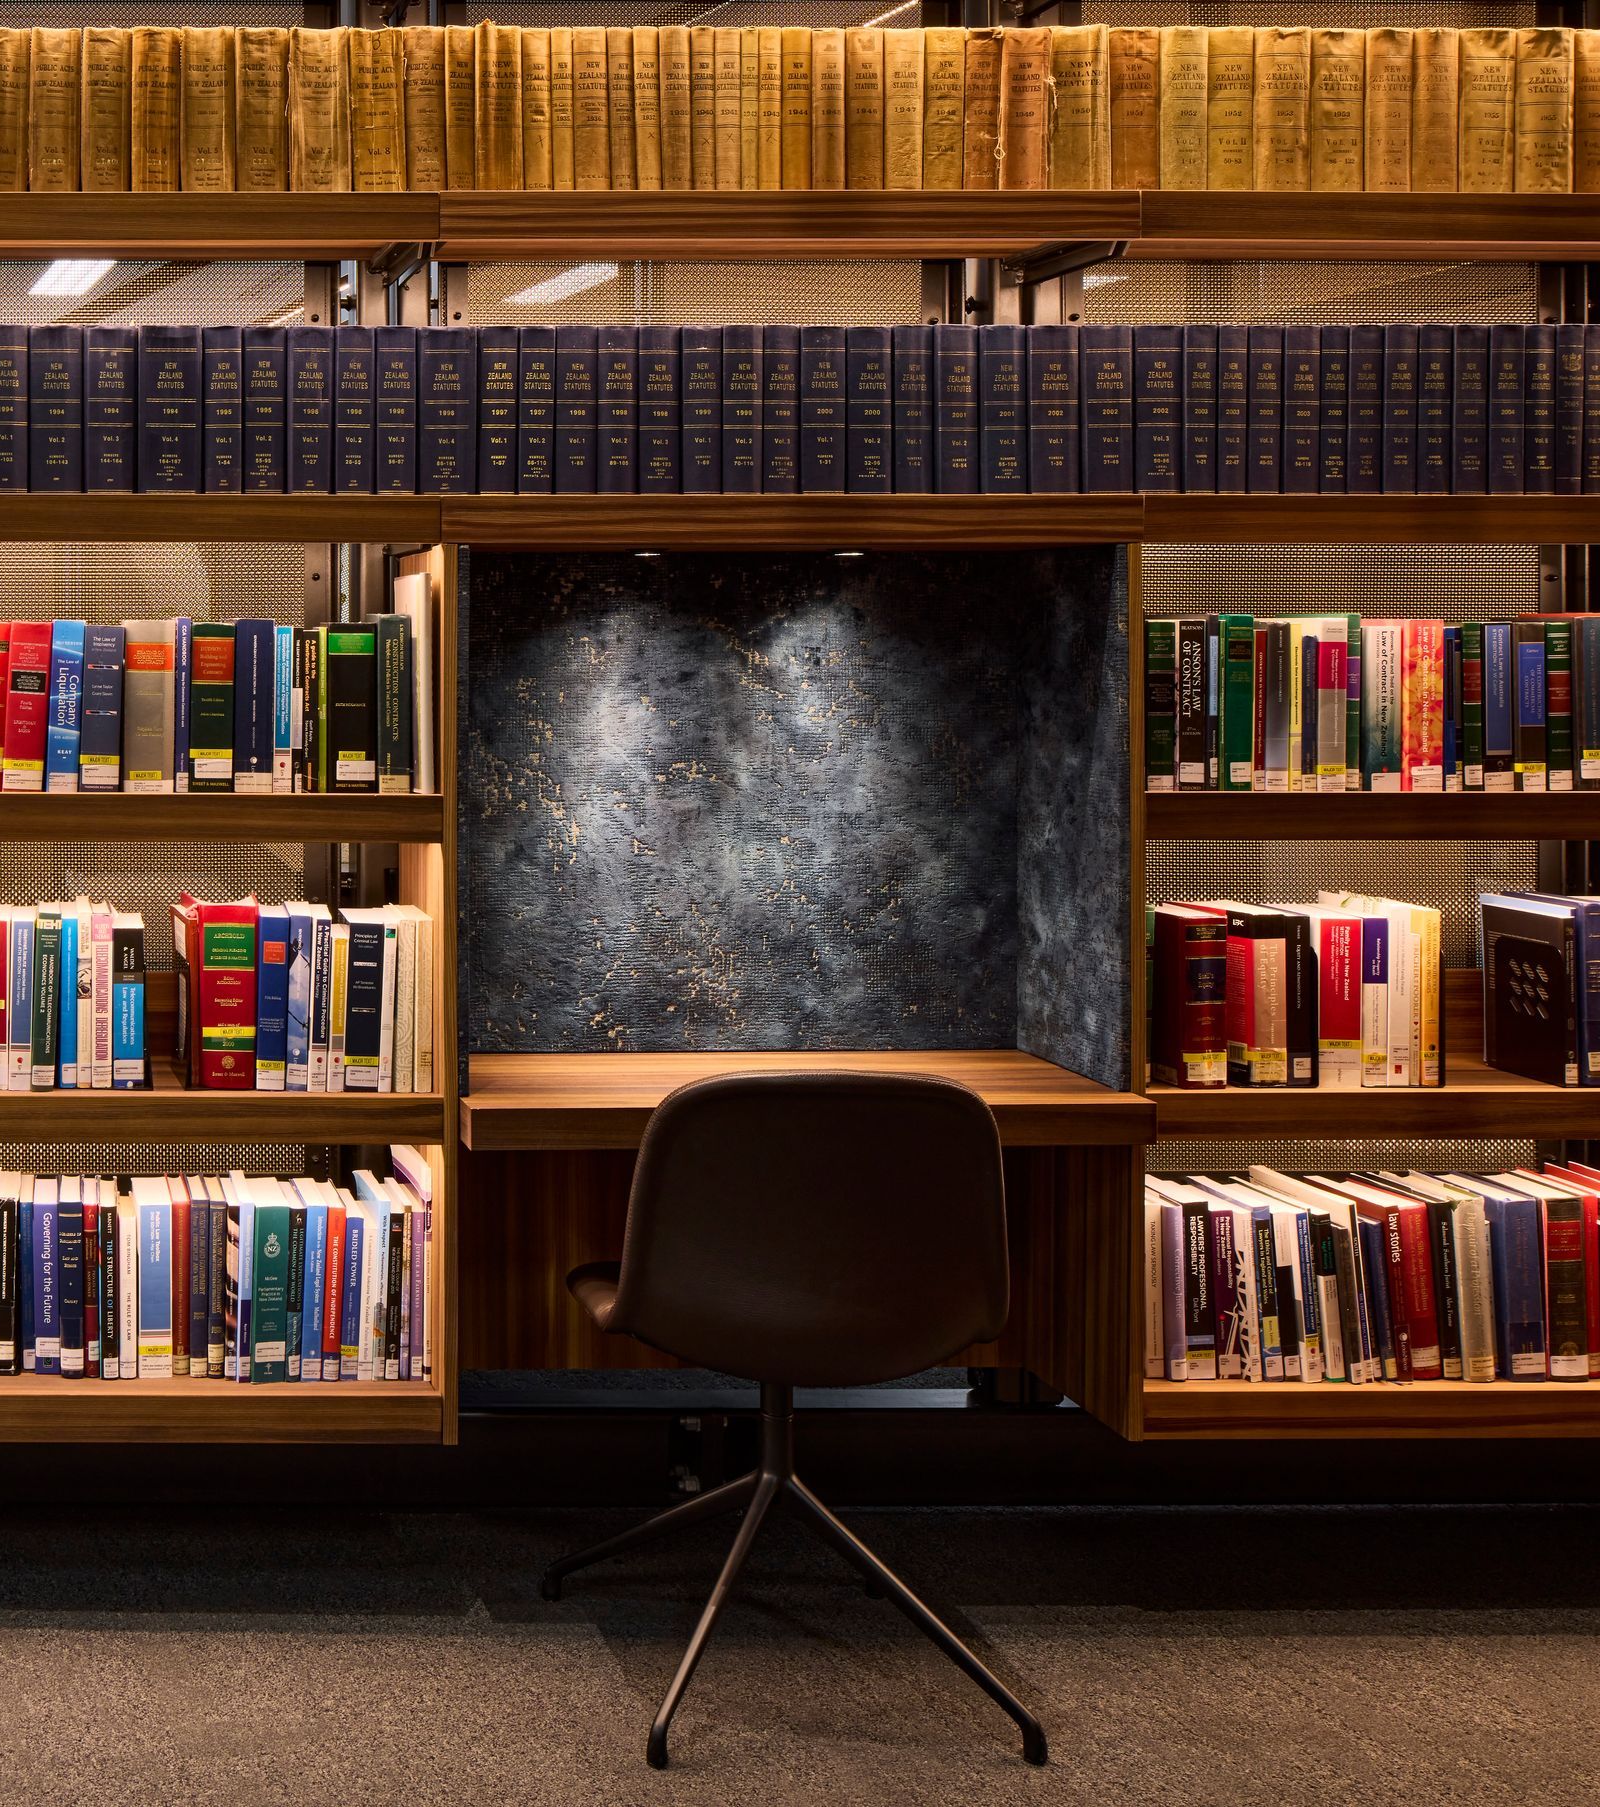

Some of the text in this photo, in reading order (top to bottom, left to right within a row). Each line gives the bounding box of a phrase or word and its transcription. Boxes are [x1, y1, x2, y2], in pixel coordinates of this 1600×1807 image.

[44, 372, 68, 380] ZEALAND
[1183, 641, 1191, 718] OF CONTRACT
[1192, 641, 1201, 711] ANSON'S LAW
[1382, 649, 1387, 657] of
[56, 668, 69, 726] Liquidation
[66, 675, 79, 726] Company
[1258, 944, 1268, 990] of Equity
[1268, 944, 1278, 1016] The Principles
[96, 944, 108, 1060] TELECOMMUNICATIONS DEREGULATION
[1190, 1216, 1198, 1275] RESPONSIBILITY
[1197, 1216, 1207, 1310] LAWYERS' PROFESSIONAL
[1389, 1213, 1402, 1263] law stories
[41, 1212, 53, 1324] Governing for the Future
[107, 1299, 113, 1308] OF
